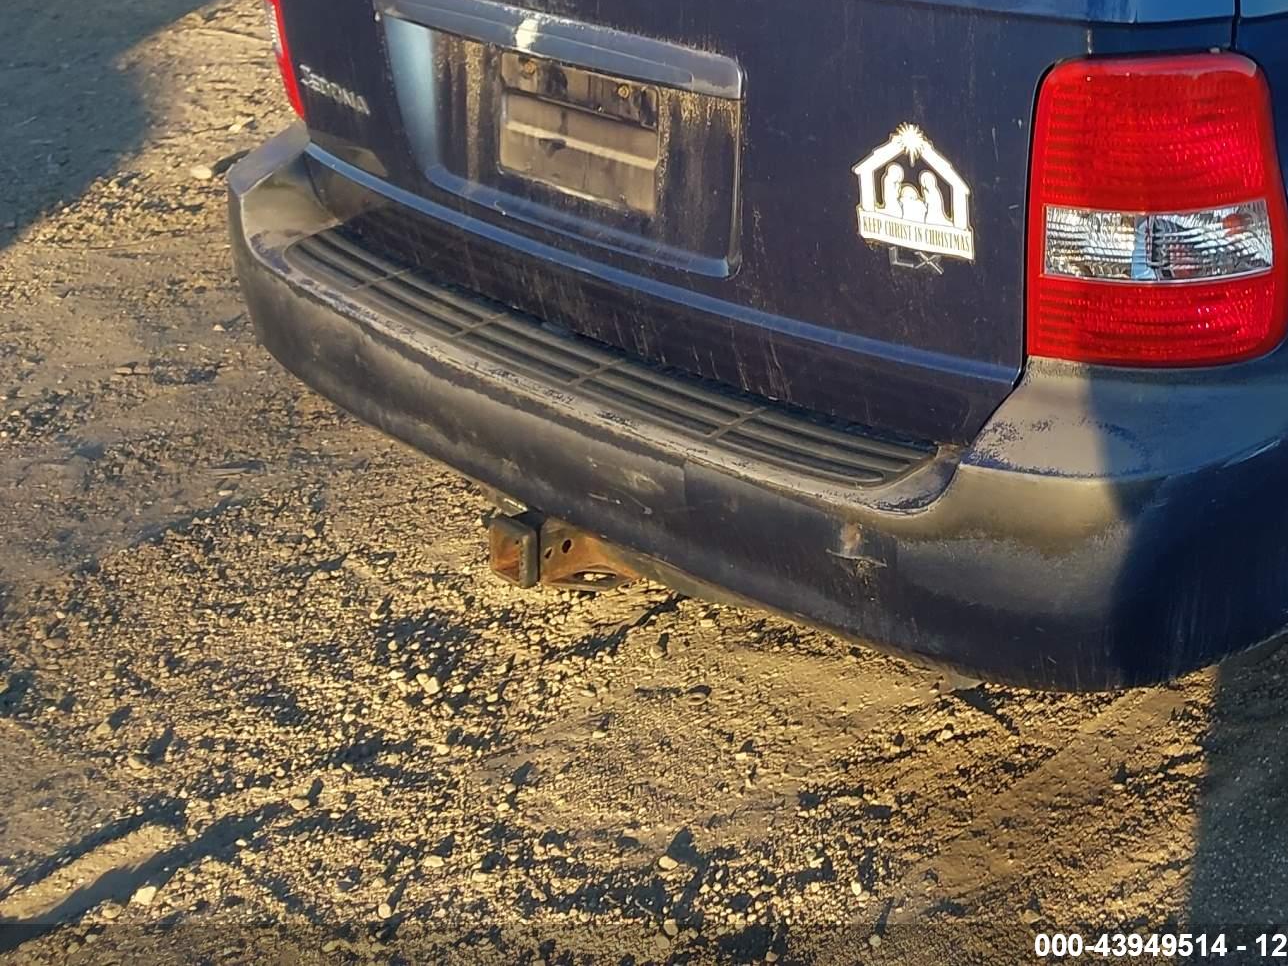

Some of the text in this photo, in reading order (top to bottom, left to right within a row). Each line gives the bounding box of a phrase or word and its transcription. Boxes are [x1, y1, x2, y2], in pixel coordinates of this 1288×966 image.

[862, 216, 970, 252] KEEP CHRIST IN CHRISTMAS
[888, 246, 945, 274] LX
